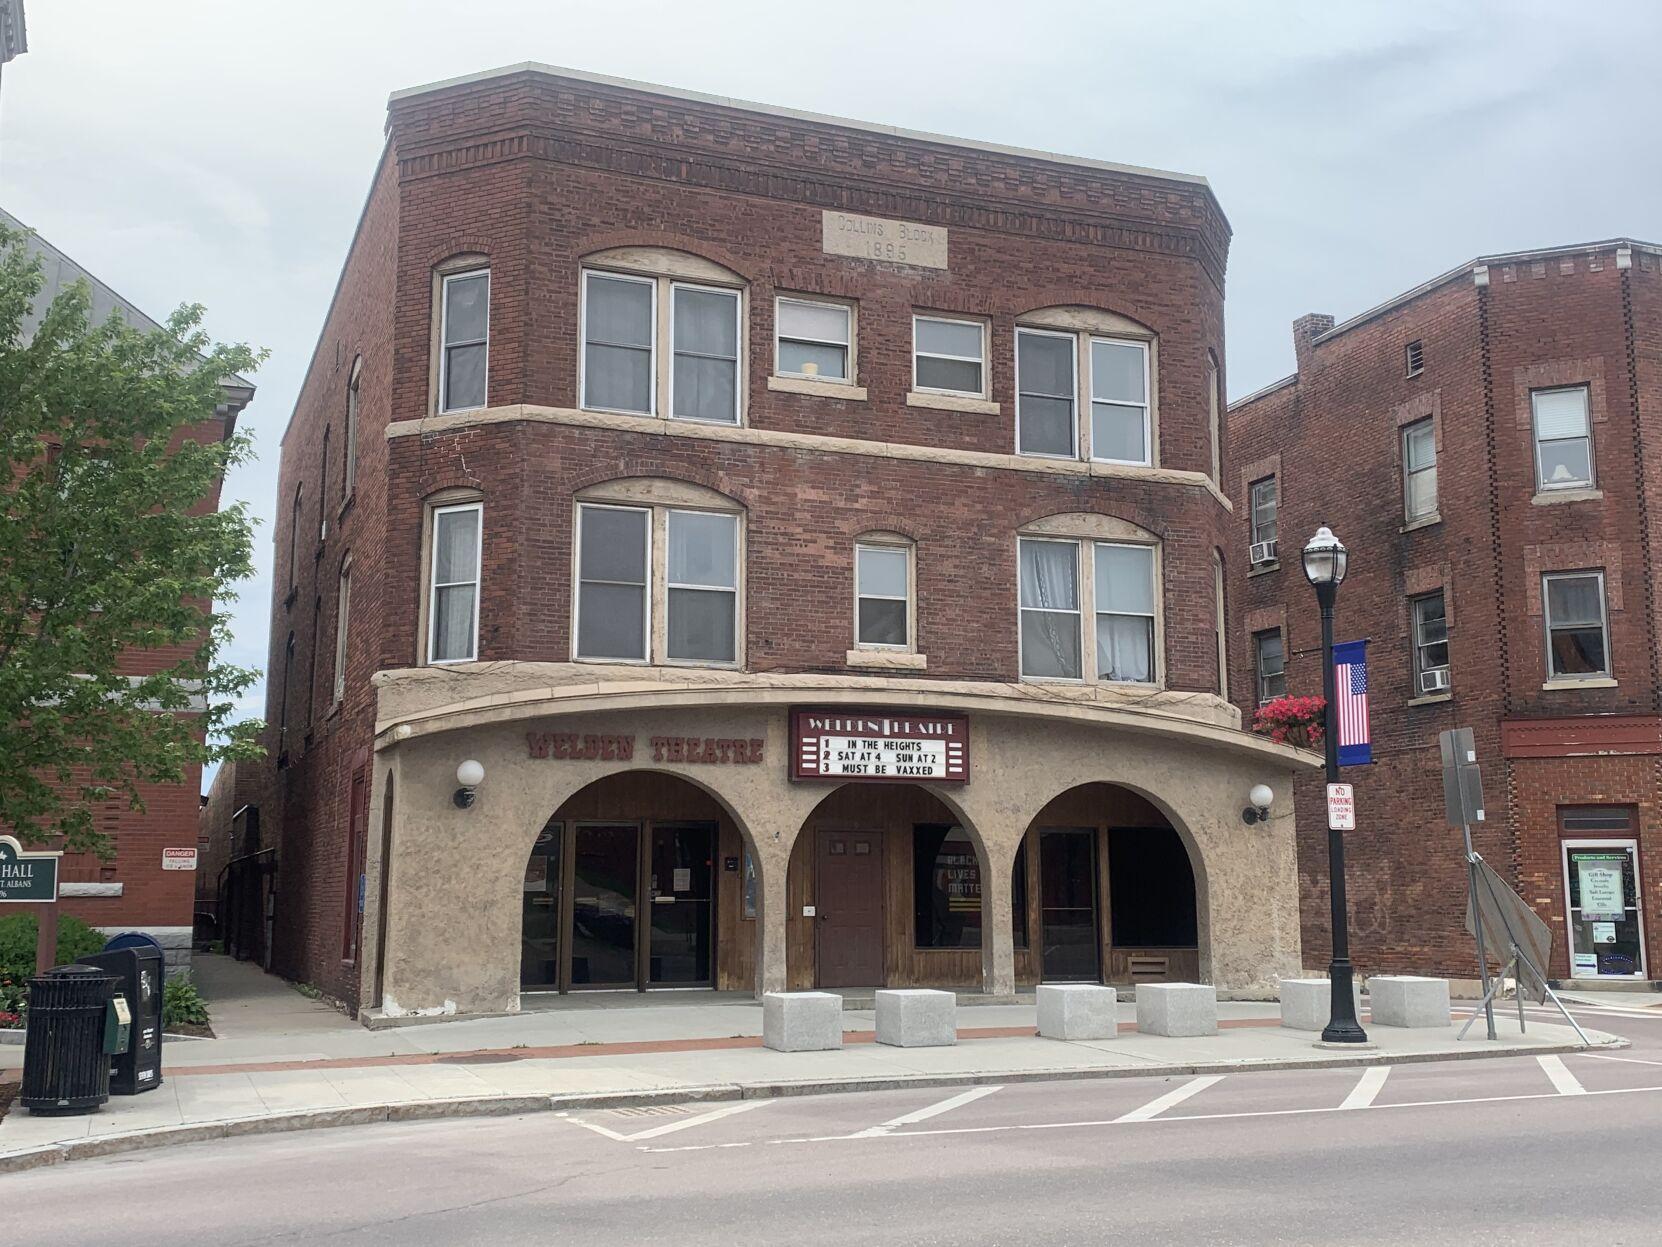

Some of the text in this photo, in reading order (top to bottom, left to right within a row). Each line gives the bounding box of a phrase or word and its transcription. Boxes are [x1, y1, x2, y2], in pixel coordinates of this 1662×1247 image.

[838, 215, 884, 236] COLLINS
[809, 718, 879, 732] WELDEN
[526, 732, 764, 764] WELDEN THEATRE
[823, 739, 922, 751] 1 IN THE HEIGHTS
[823, 751, 936, 763] 2 SAT AT 4 SUN AT 2
[823, 763, 933, 775] 3 MUST BE VAXXED
[1335, 788, 1345, 796] NO
[1, 864, 34, 878] HALL
[947, 869, 976, 879] LIVES
[6, 880, 32, 888] ALBANS
[948, 883, 981, 893] MATTE
